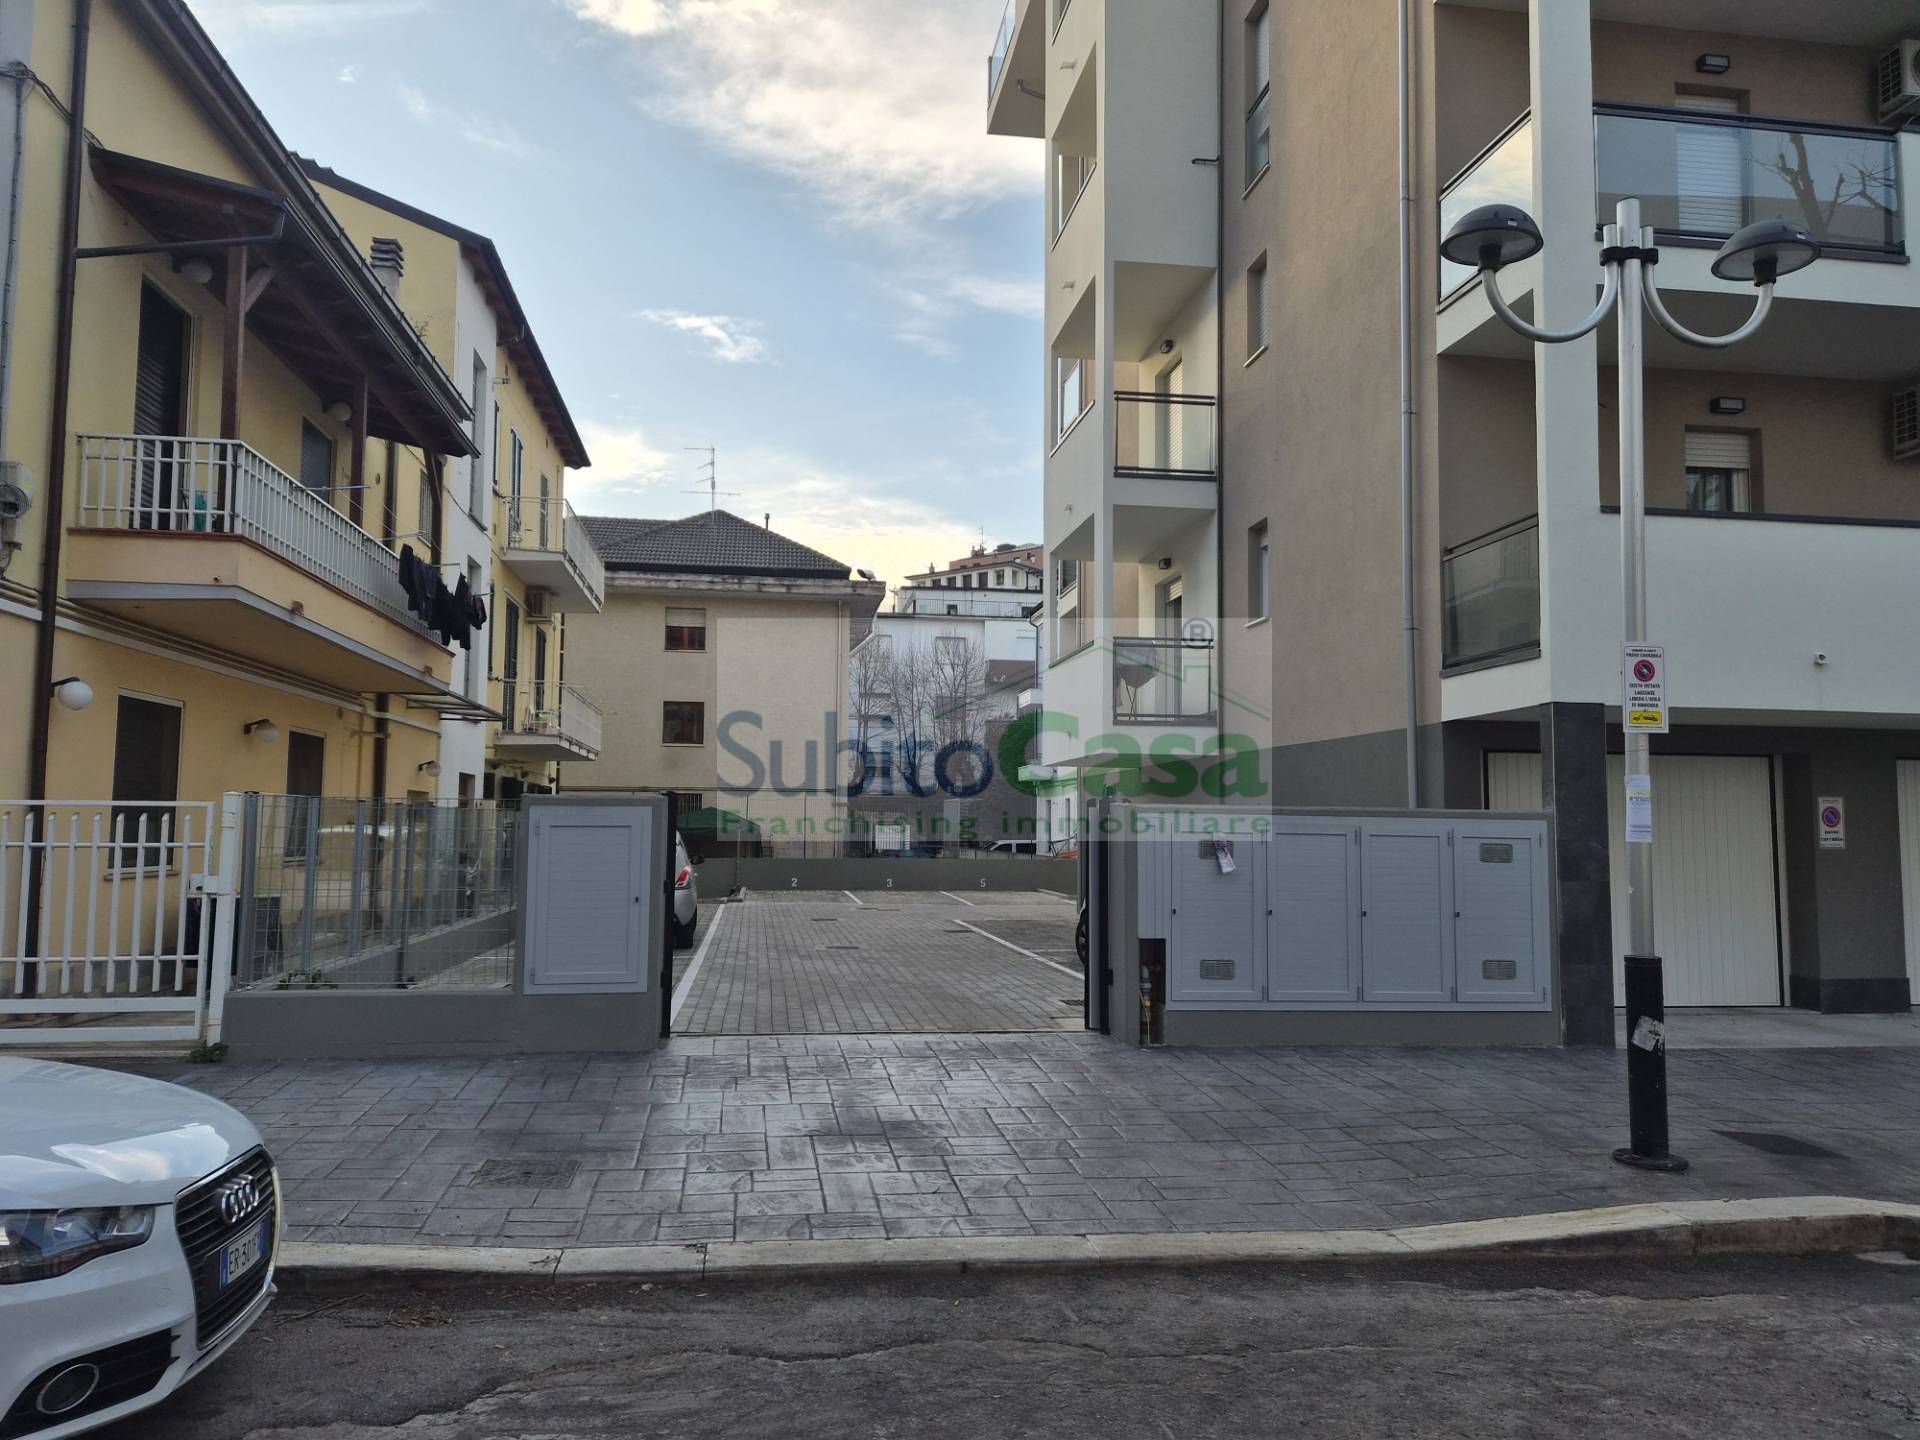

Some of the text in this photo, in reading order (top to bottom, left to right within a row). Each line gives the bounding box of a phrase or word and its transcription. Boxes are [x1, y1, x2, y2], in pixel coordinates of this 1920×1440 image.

[791, 877, 798, 887] 2
[886, 878, 893, 888] 3
[980, 878, 986, 888] 5
